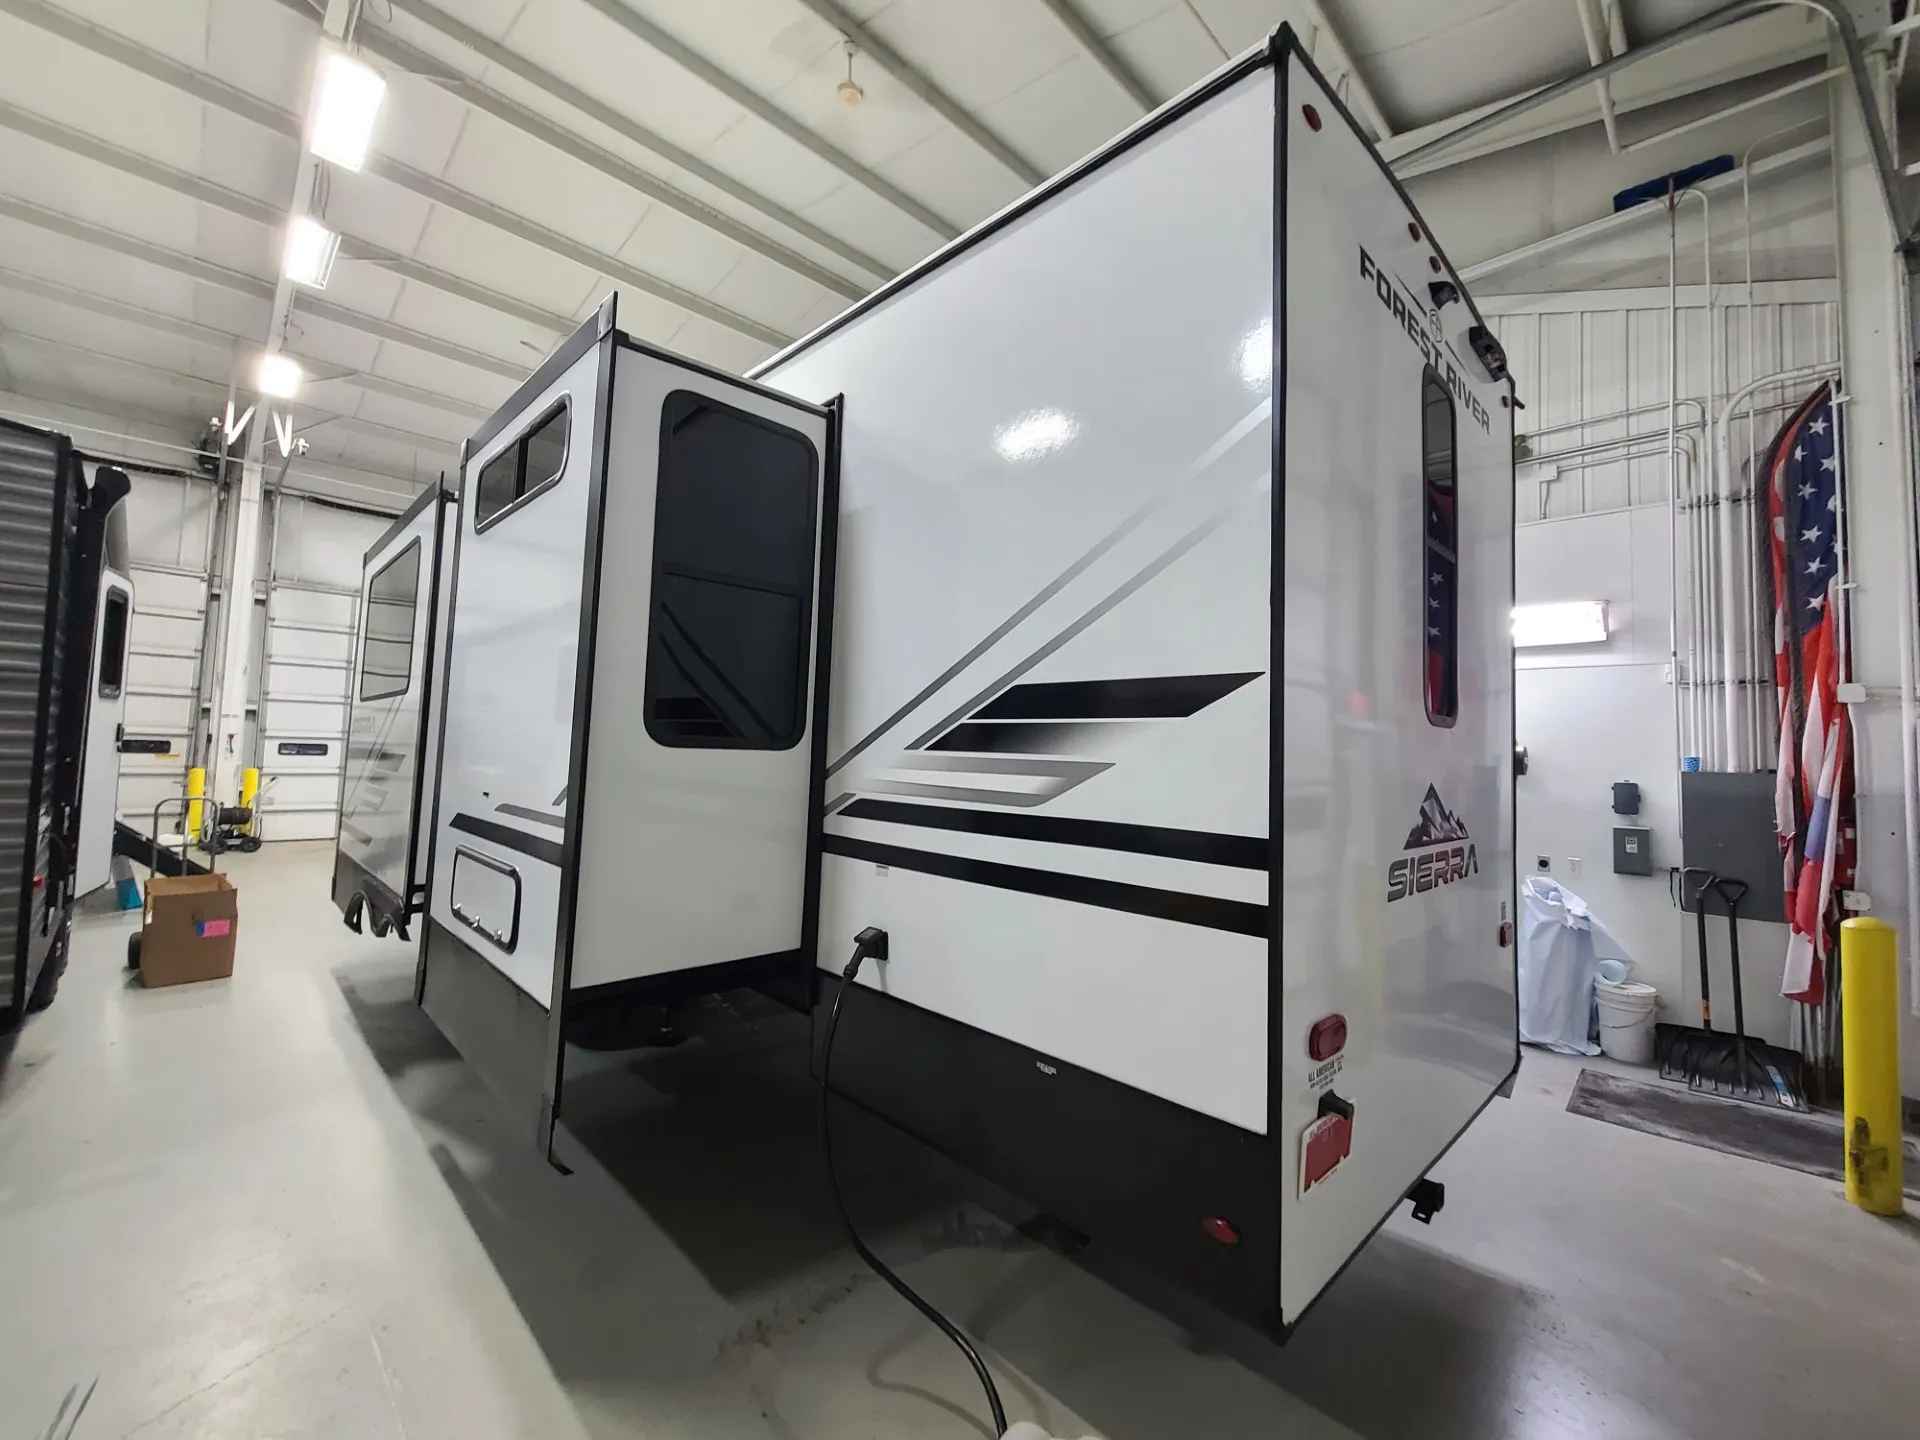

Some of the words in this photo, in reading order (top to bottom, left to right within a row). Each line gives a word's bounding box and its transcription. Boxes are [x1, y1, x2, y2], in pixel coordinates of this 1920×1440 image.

[1359, 244, 1443, 374] FOREST
[1446, 361, 1491, 435] RIVER
[1387, 843, 1478, 903] SIERRA
